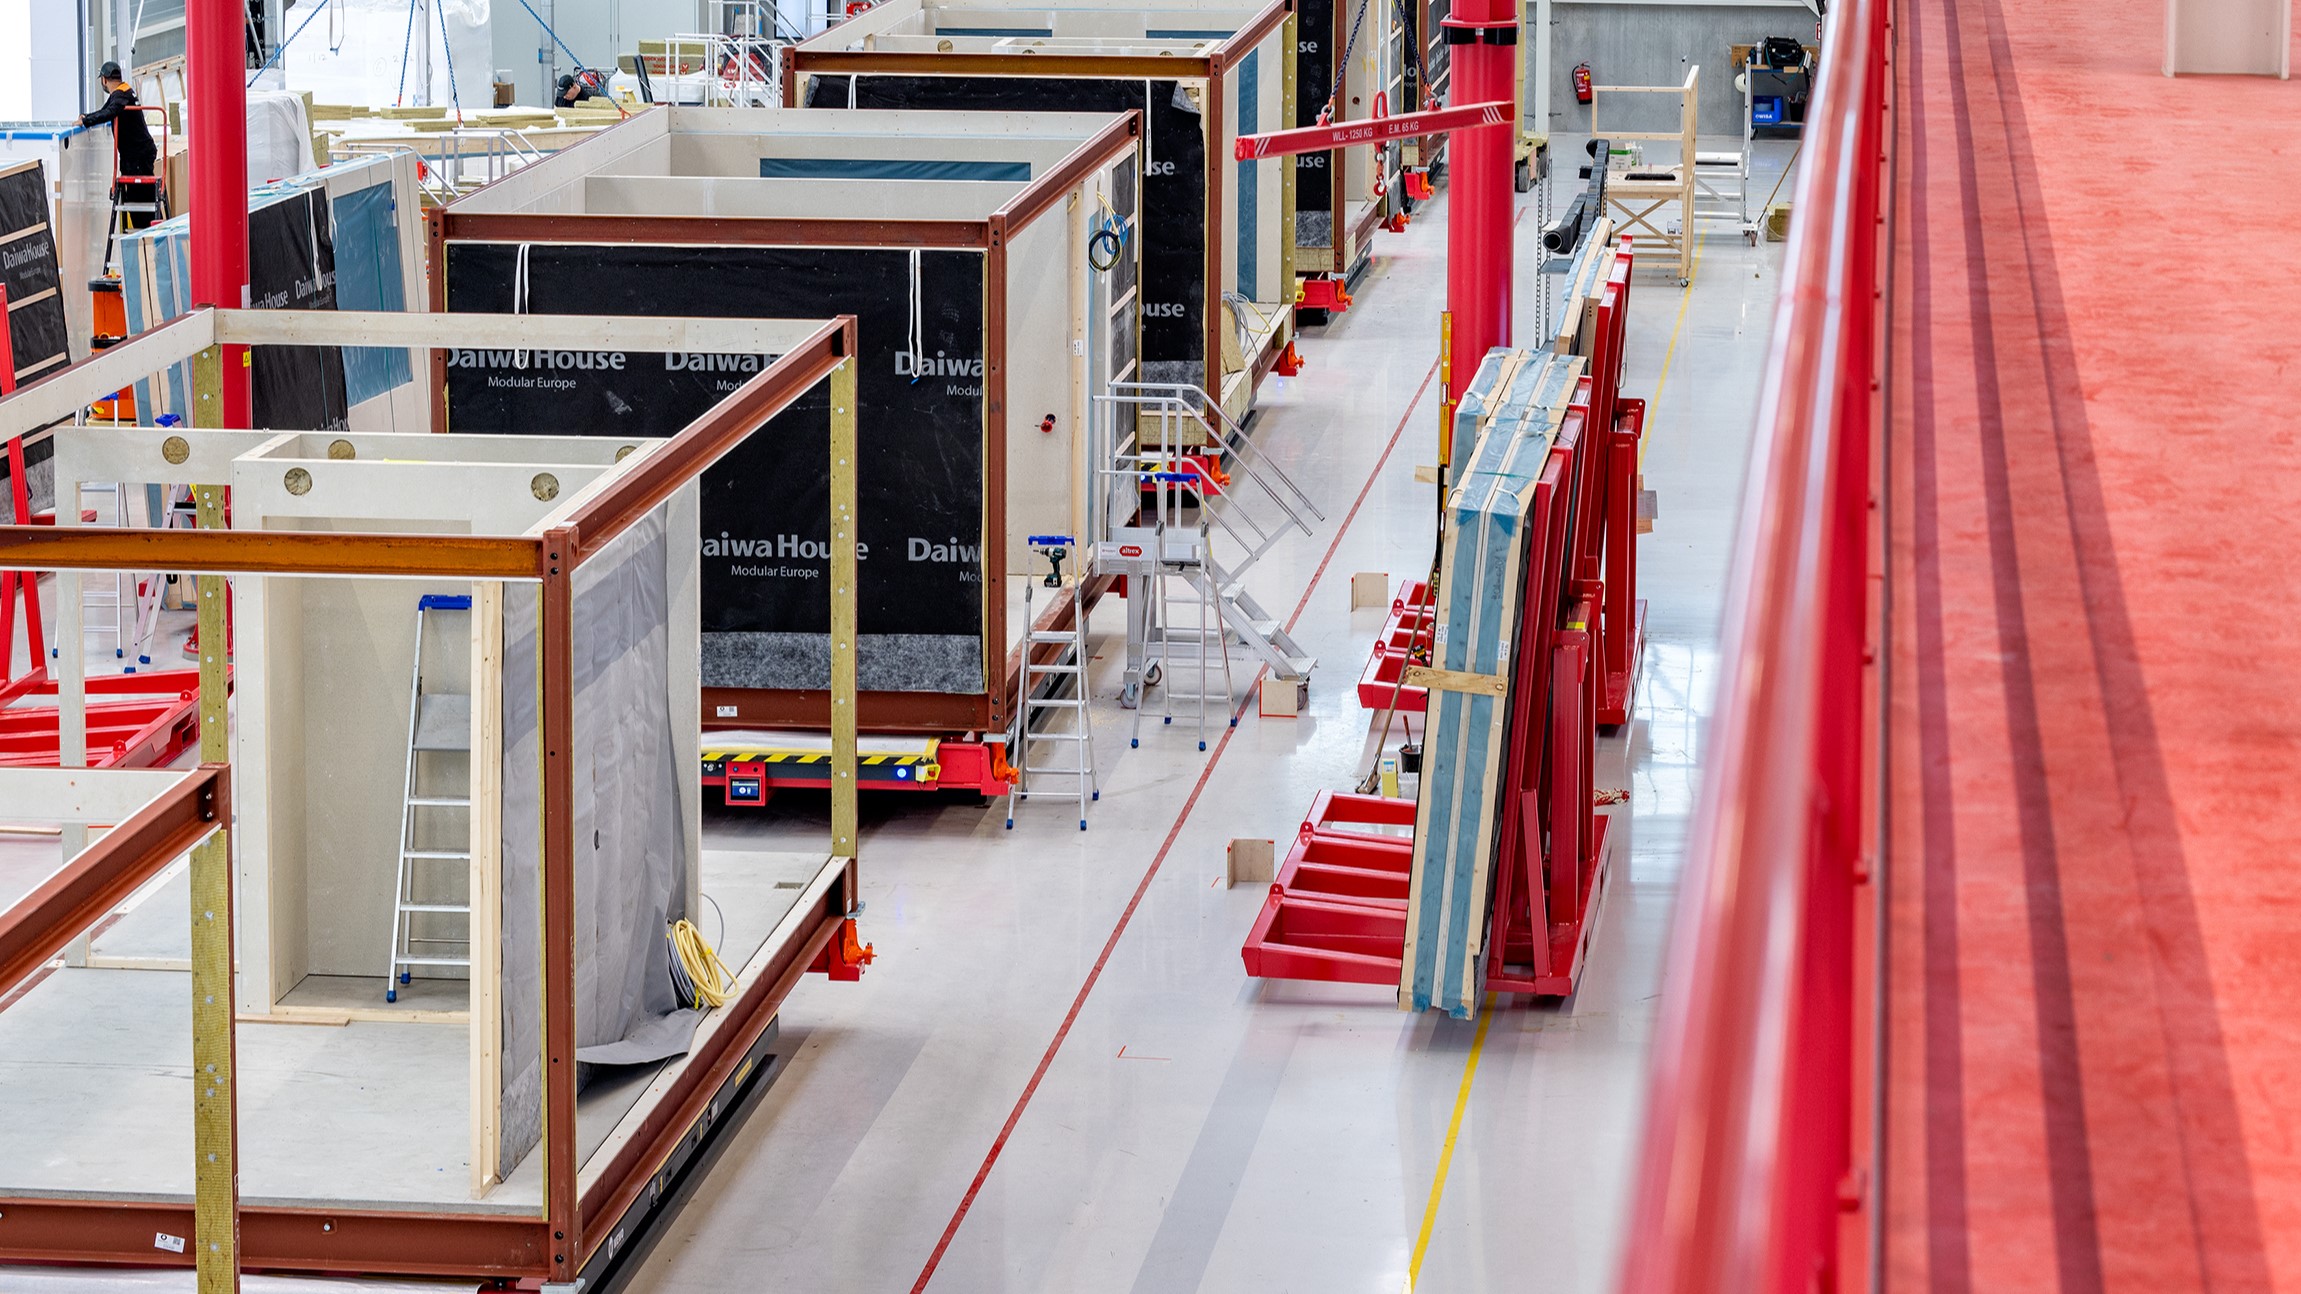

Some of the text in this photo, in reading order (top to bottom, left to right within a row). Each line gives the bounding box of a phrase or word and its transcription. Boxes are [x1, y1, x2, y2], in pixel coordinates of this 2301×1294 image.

[1364, 127, 1373, 137] KG
[1402, 122, 1409, 132] 65
[1410, 121, 1419, 131] KG
[3, 241, 49, 270] Daiwa House
[534, 350, 626, 370] House
[665, 352, 758, 372] Daiwa
[895, 350, 983, 377] Daiwa
[488, 376, 577, 390] Modular Europe
[700, 531, 868, 560] aiwa Houe
[1122, 546, 1140, 554] altrex
[731, 565, 819, 580] Modular Europe
